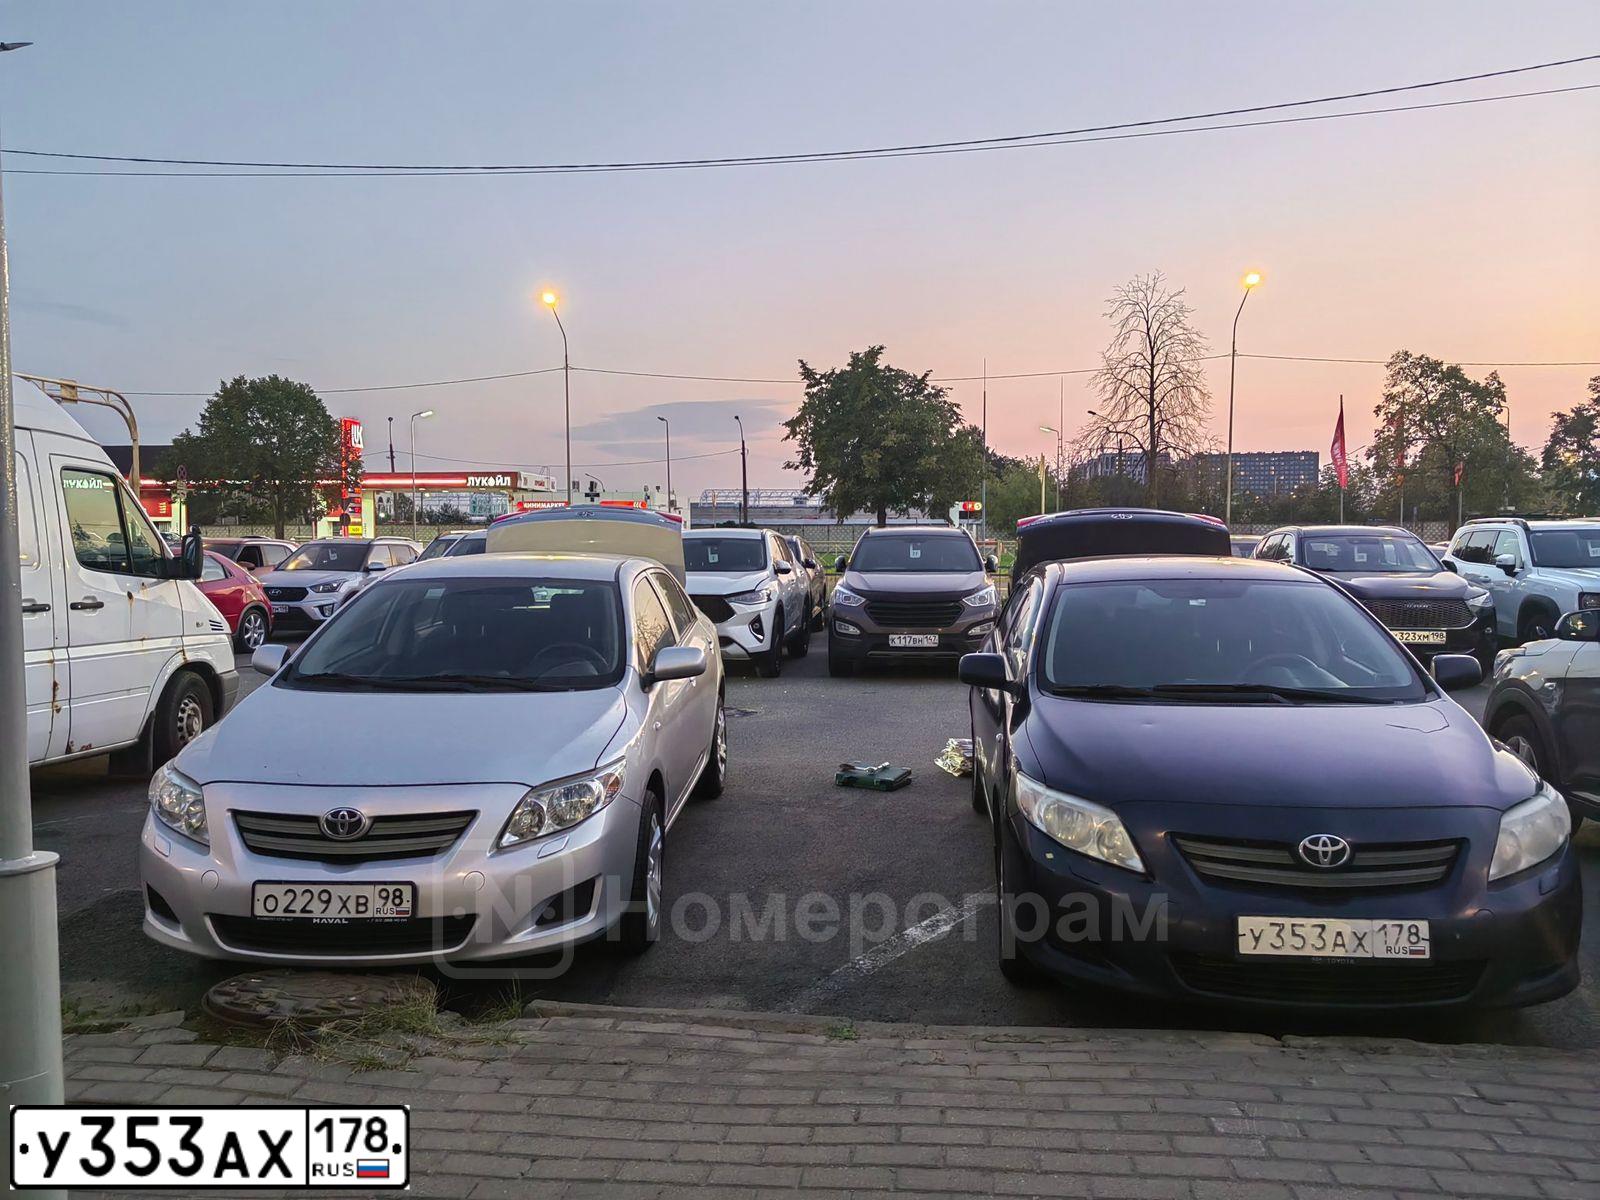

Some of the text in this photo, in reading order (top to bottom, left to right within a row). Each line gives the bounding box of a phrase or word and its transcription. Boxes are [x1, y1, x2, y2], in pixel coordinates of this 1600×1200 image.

[1430, 631, 1444, 640] 198
[263, 887, 404, 914] О229ХВ 98
[375, 907, 395, 915] RUS
[1249, 921, 1421, 954] У353АХ 178
[1385, 946, 1409, 955] RUS
